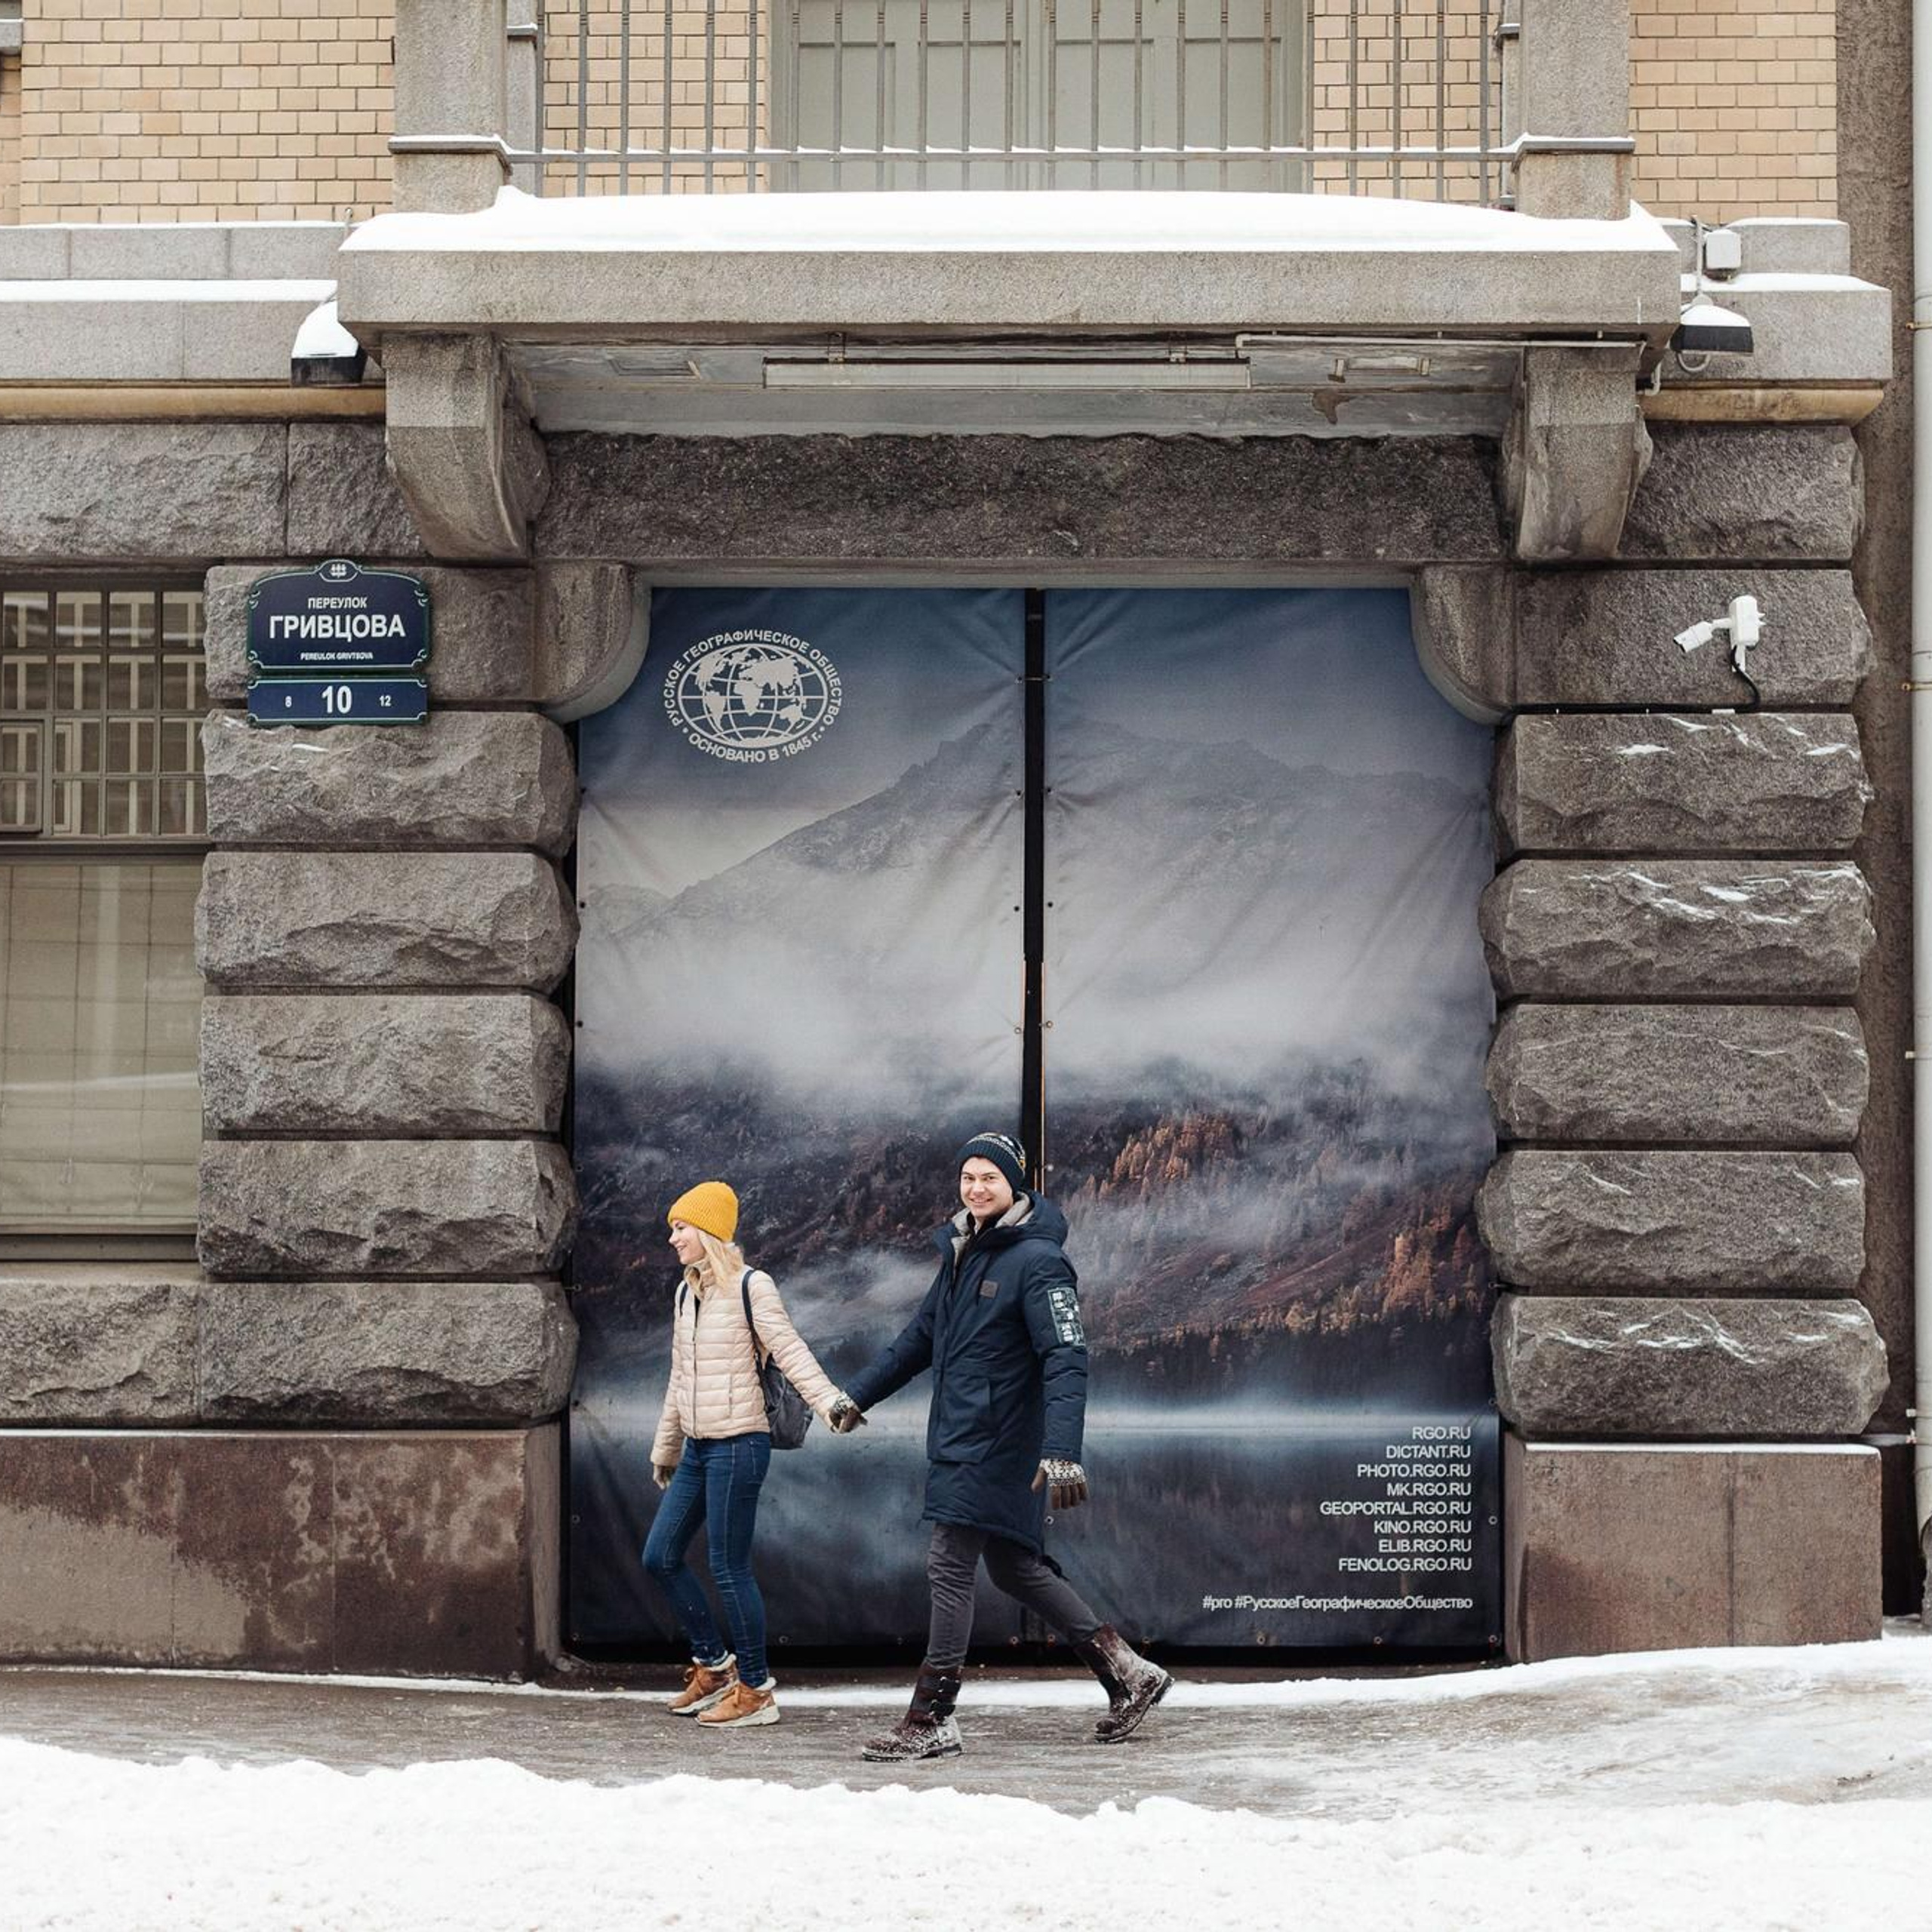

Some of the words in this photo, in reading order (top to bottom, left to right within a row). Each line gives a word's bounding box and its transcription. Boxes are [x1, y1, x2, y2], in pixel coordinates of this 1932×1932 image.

[307, 597, 368, 609] ПЕРЕУЛОК
[269, 614, 406, 642] ГРИВЦОВА
[300, 652, 336, 660] PEREULOK
[663, 660, 685, 728] РУССКОЕ
[685, 629, 810, 663] ГЕОГРАФИЧЕСКОЕ
[809, 647, 842, 726] ОБЩЕСТВО
[285, 696, 292, 708] 8
[321, 685, 352, 714] 10
[379, 695, 391, 707] 12
[688, 733, 766, 763] ОСНОВАНО
[768, 749, 780, 761] В
[782, 737, 813, 758] 1845
[1412, 1426, 1472, 1440] RGO.RU
[1386, 1445, 1472, 1459] DICTANT.RU
[1357, 1464, 1472, 1478] PHOTO.RGO.RU
[1386, 1483, 1472, 1496] MK.RGO.RU
[1320, 1501, 1472, 1515] GEOPORTAL.RGO.RU
[1374, 1520, 1472, 1534] KINO.RGO.RU
[1379, 1539, 1472, 1552] ELIB.RGO.RU
[1339, 1558, 1472, 1572] FENOLOG.RGO.RU
[1235, 1595, 1473, 1612] #РусскоеГеографическоеОбщество
